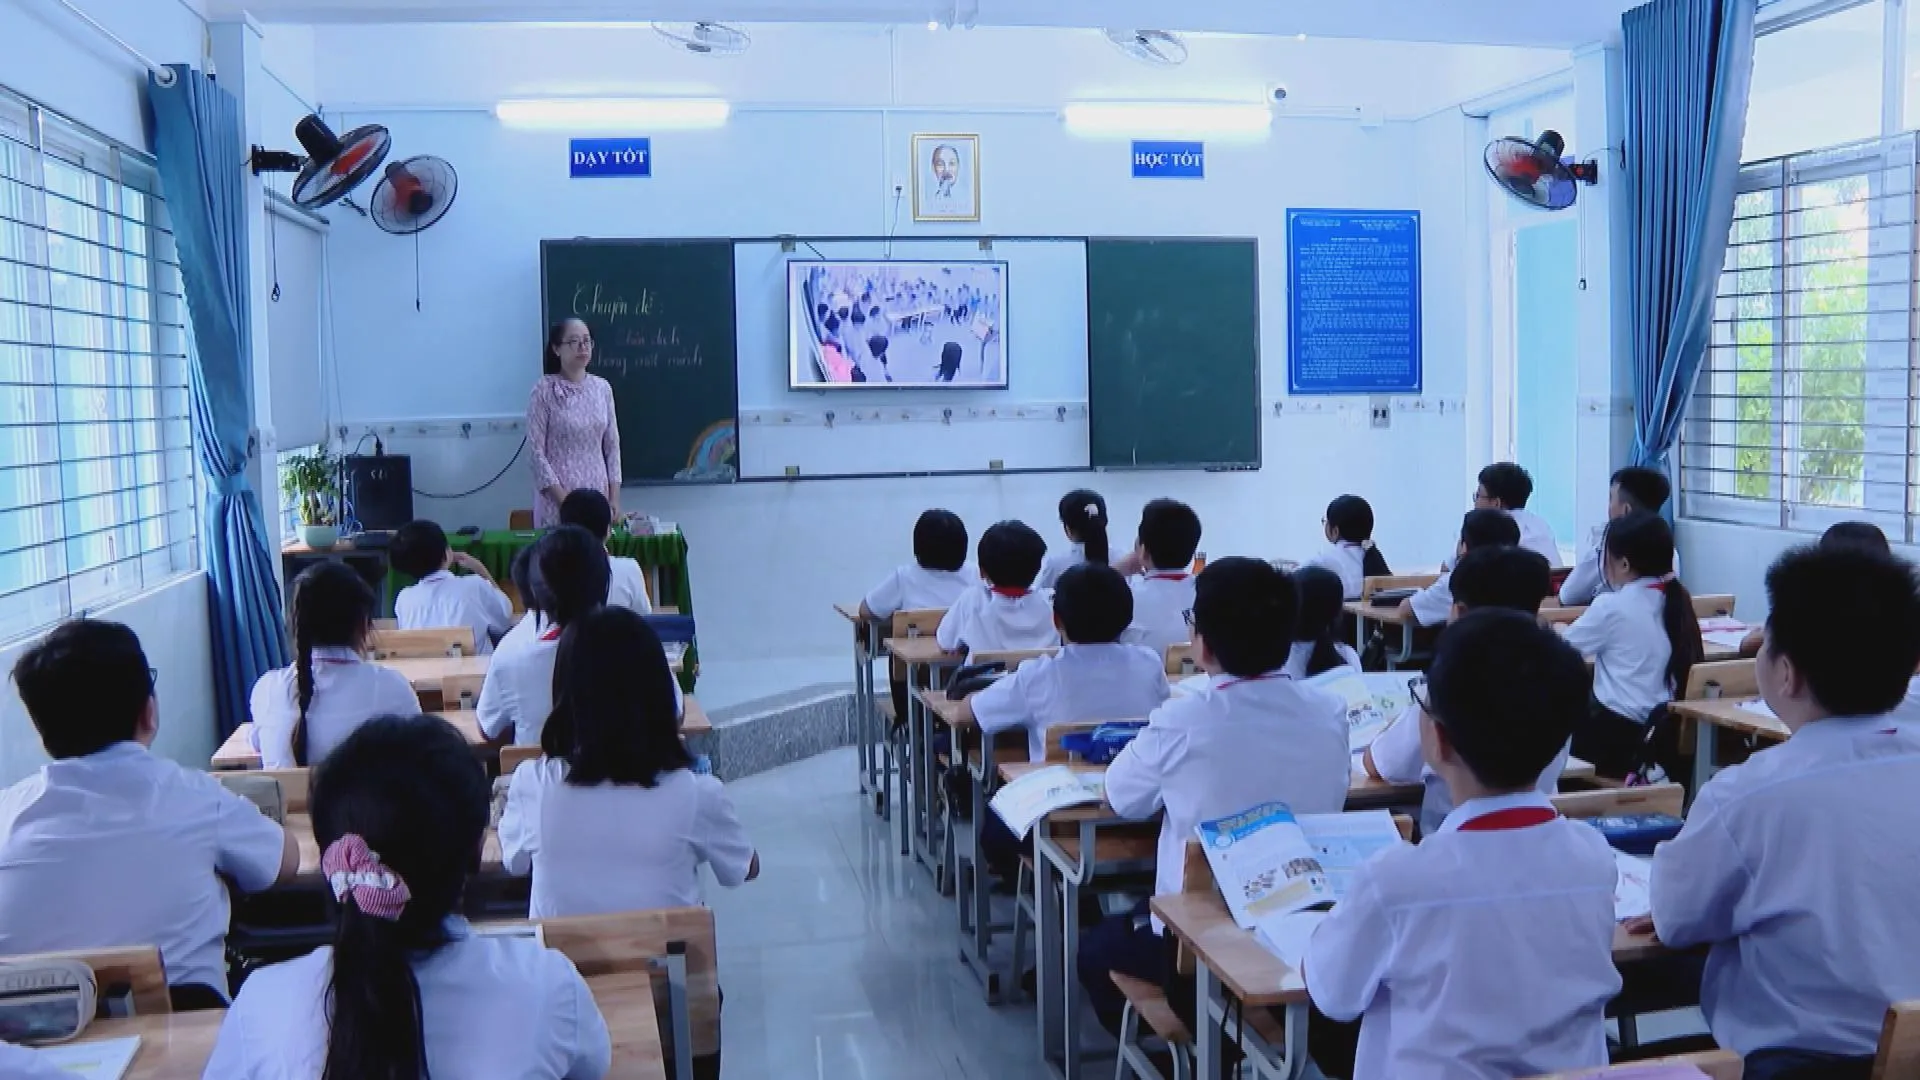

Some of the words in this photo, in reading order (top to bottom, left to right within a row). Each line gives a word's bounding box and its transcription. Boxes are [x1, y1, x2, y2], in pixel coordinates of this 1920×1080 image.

[574, 151, 608, 168] DẠY
[612, 146, 648, 165] TỐT
[1135, 153, 1168, 168] HỌC
[1171, 149, 1204, 167] TỐT
[572, 281, 627, 323] Chuyên
